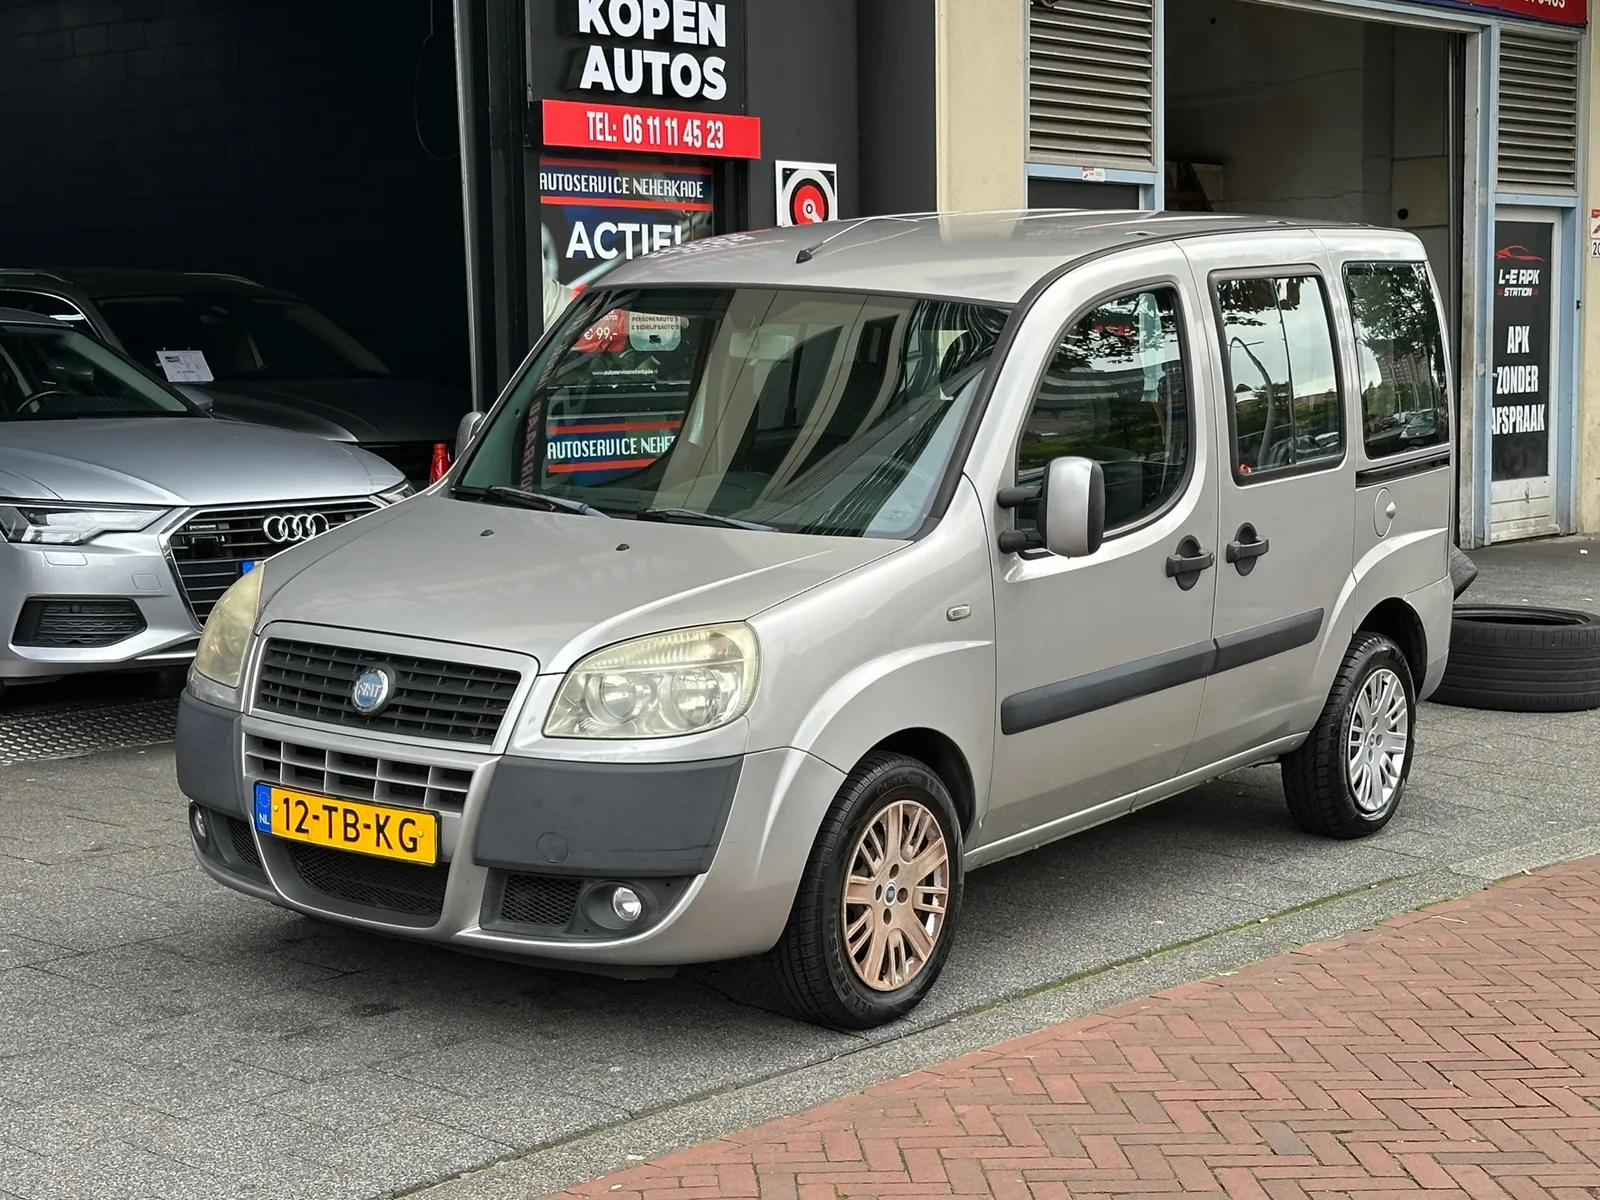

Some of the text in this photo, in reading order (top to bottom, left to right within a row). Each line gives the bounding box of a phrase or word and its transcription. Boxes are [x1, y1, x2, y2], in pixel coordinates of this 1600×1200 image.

[578, 0, 726, 47] KOPEN
[579, 45, 727, 100] AUTOS
[586, 111, 724, 149] TEL: 06 11 11 45 23
[539, 172, 703, 198] AUTOSERVICE NEHERKADE
[1518, 269, 1540, 284] APK
[1503, 287, 1532, 296] STATION
[1507, 325, 1530, 354] APK
[1496, 365, 1539, 395] ZONDER
[547, 438, 637, 459] AUTOSERVICE
[259, 813, 271, 825] NL
[283, 797, 418, 853] 12-TB-KG
